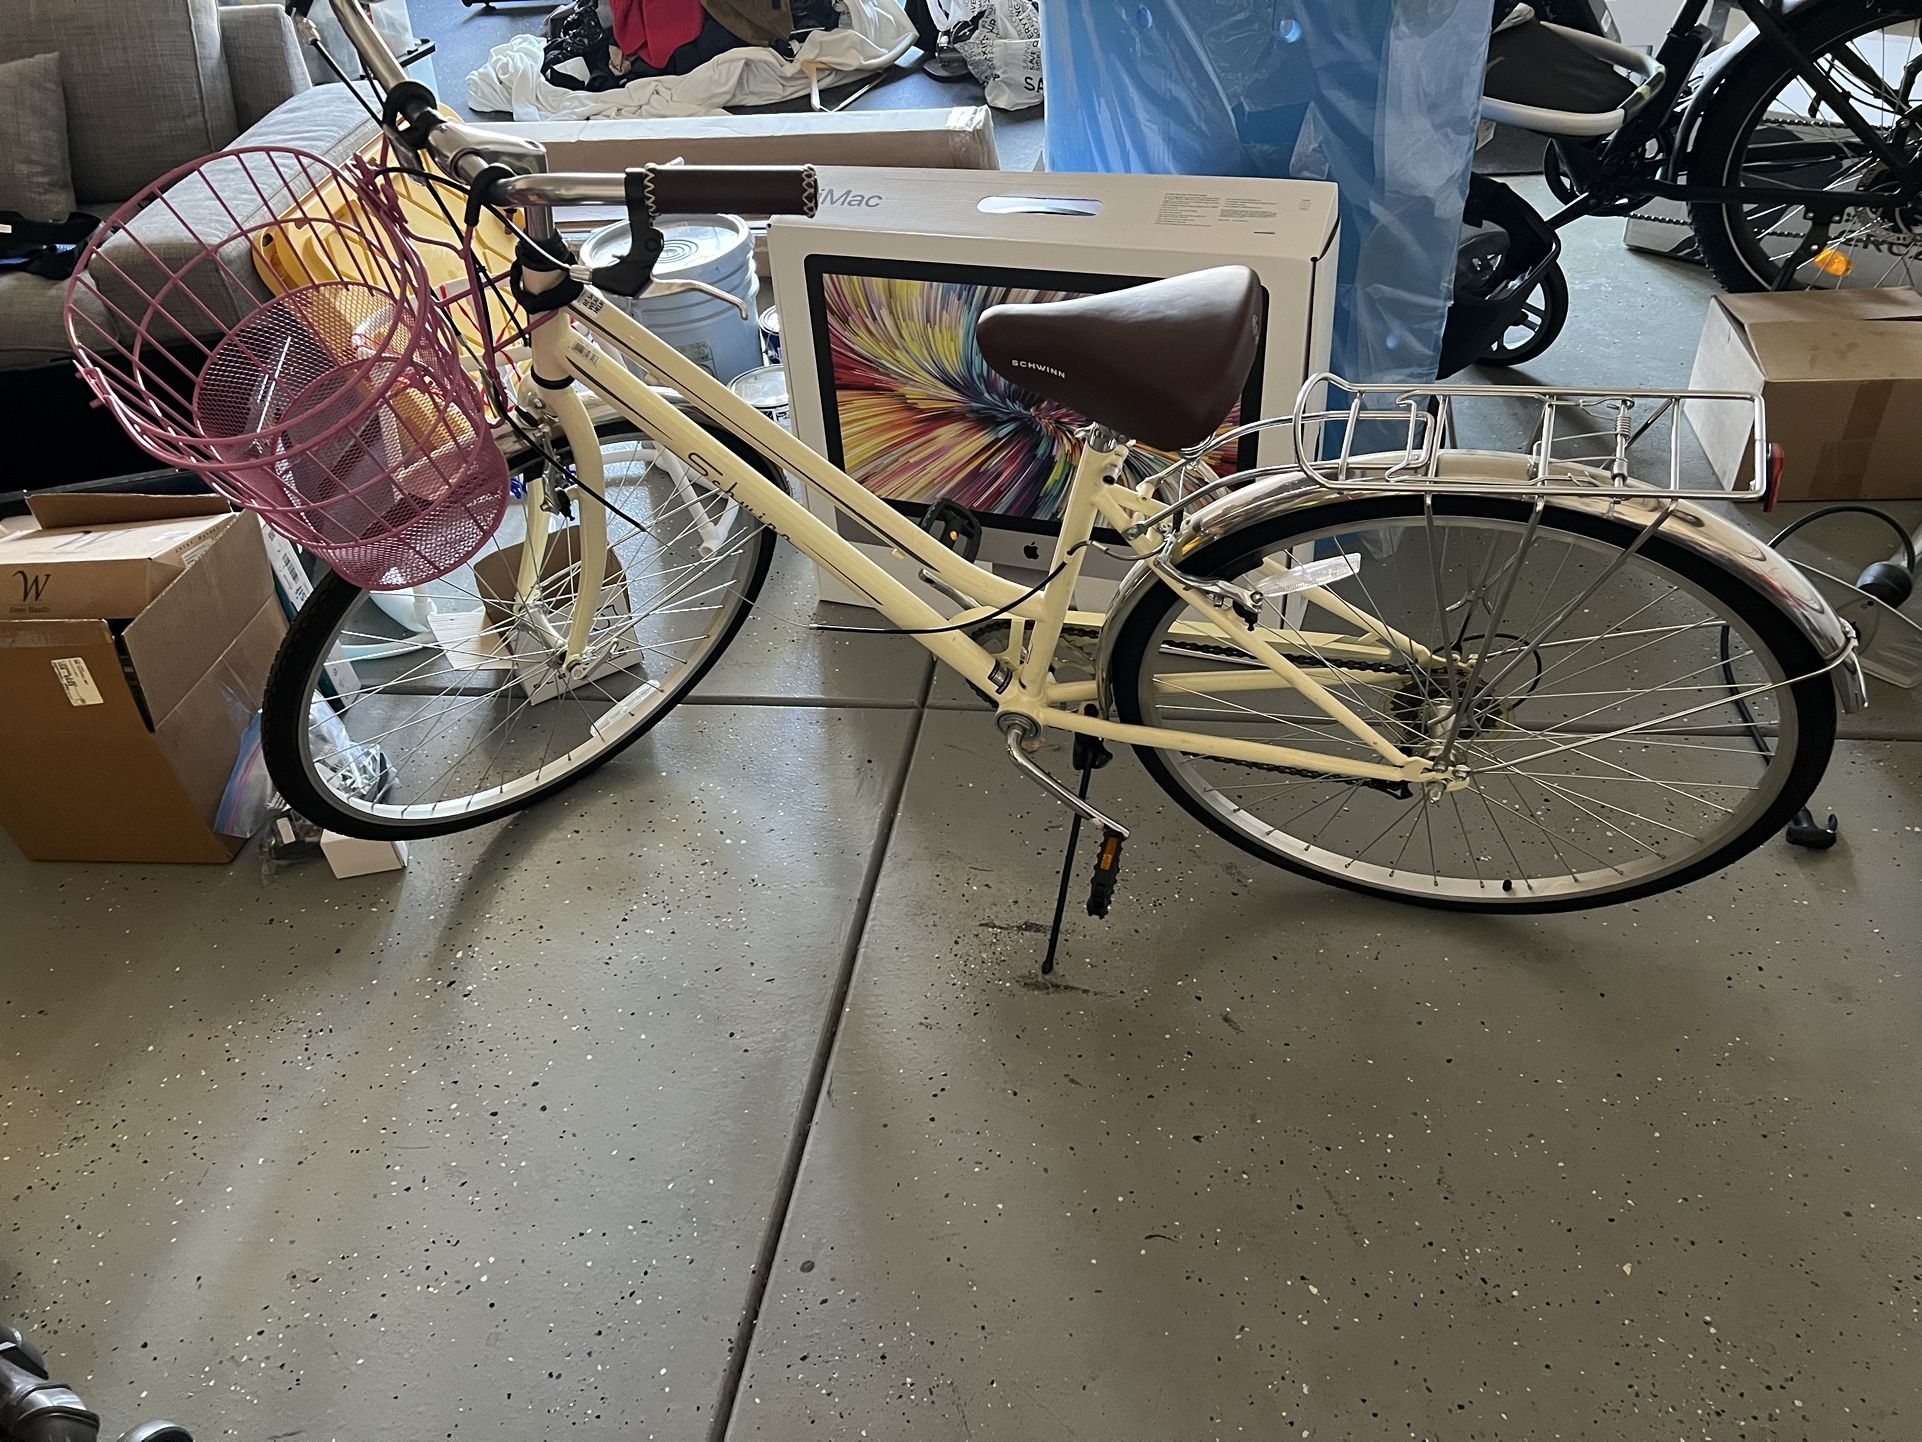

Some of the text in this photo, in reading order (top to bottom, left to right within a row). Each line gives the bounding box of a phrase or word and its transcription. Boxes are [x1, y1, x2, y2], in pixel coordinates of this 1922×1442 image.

[818, 188, 883, 208] iMac
[1011, 359, 1065, 379] SCHWINN
[12, 570, 52, 602] W
